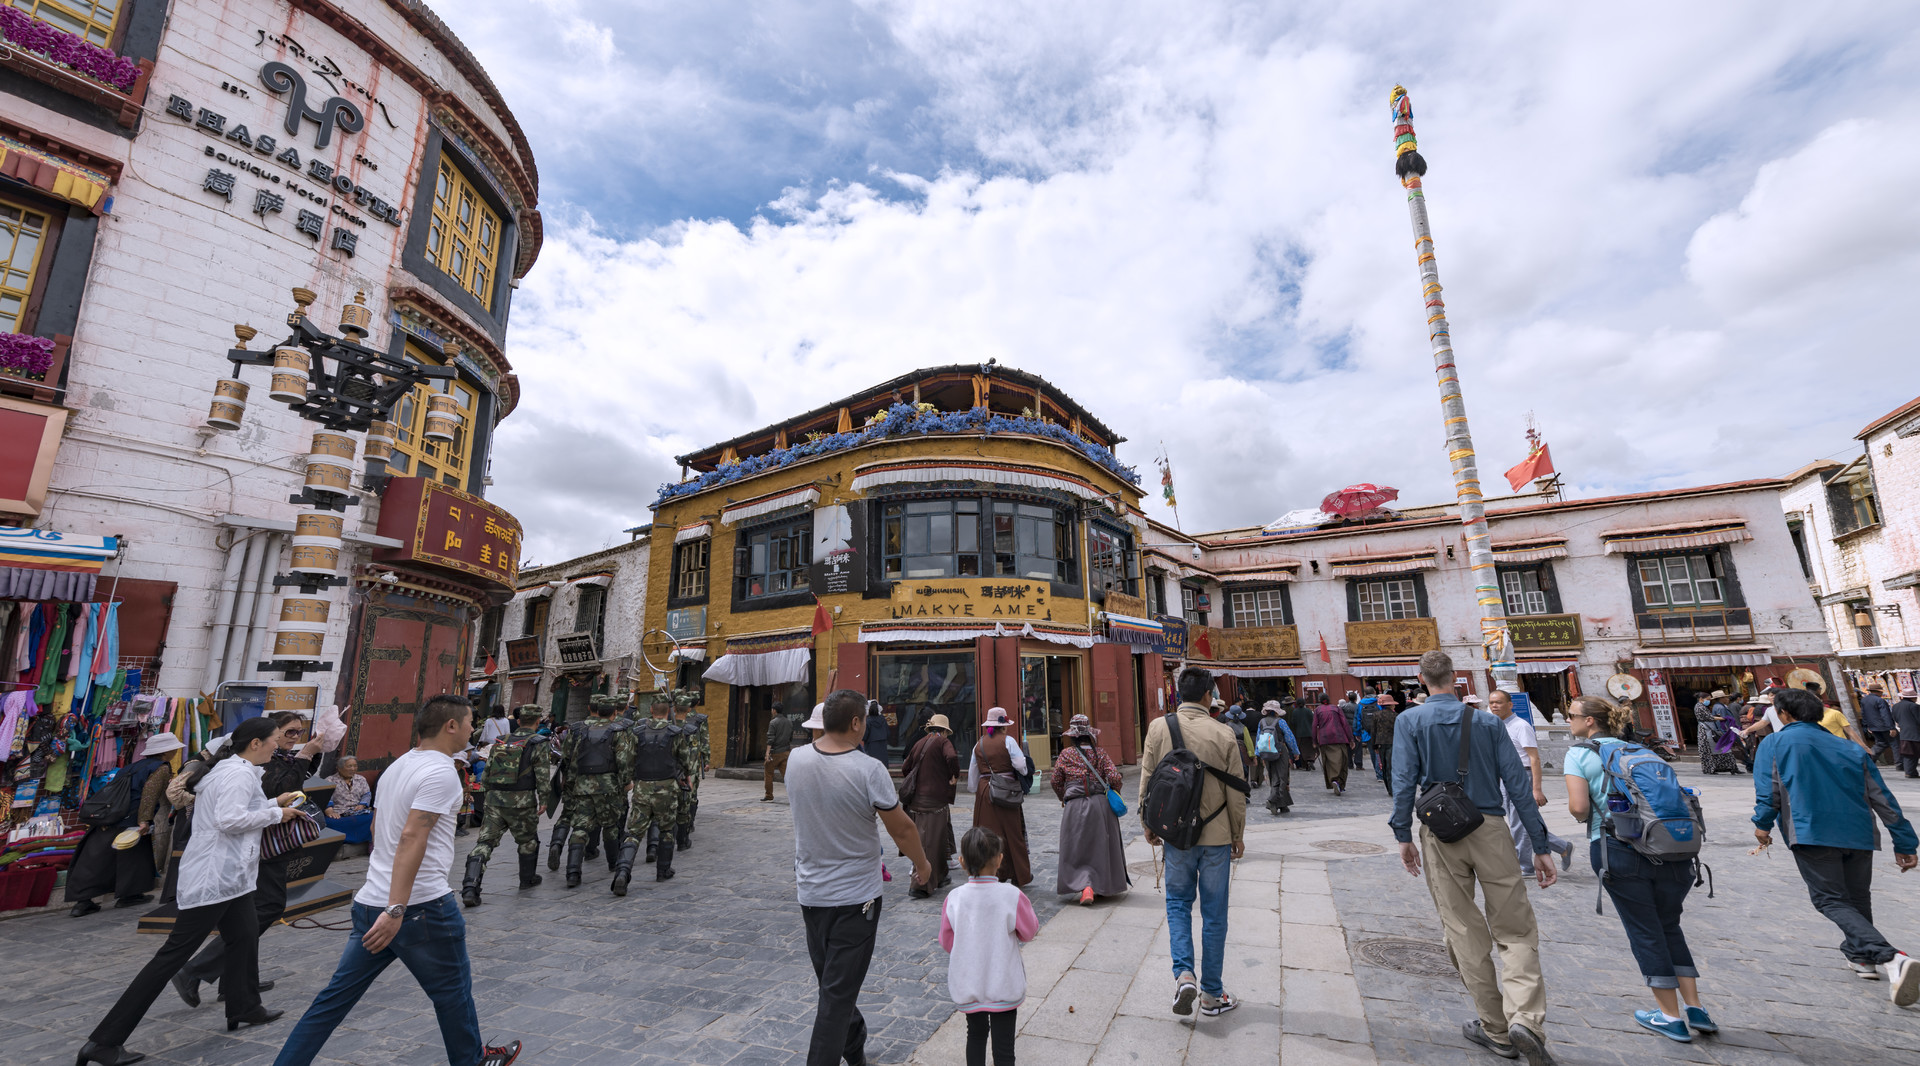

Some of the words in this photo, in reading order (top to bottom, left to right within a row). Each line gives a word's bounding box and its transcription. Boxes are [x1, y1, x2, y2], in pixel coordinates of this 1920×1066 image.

[221, 81, 250, 100] EST.
[165, 93, 302, 171] RHASA
[307, 158, 402, 228] HOTEL
[203, 145, 281, 184] Boutique
[286, 180, 328, 208] Hotel
[331, 204, 367, 229] Chain
[900, 604, 975, 616] MAKYE
[992, 604, 1036, 616] AME
